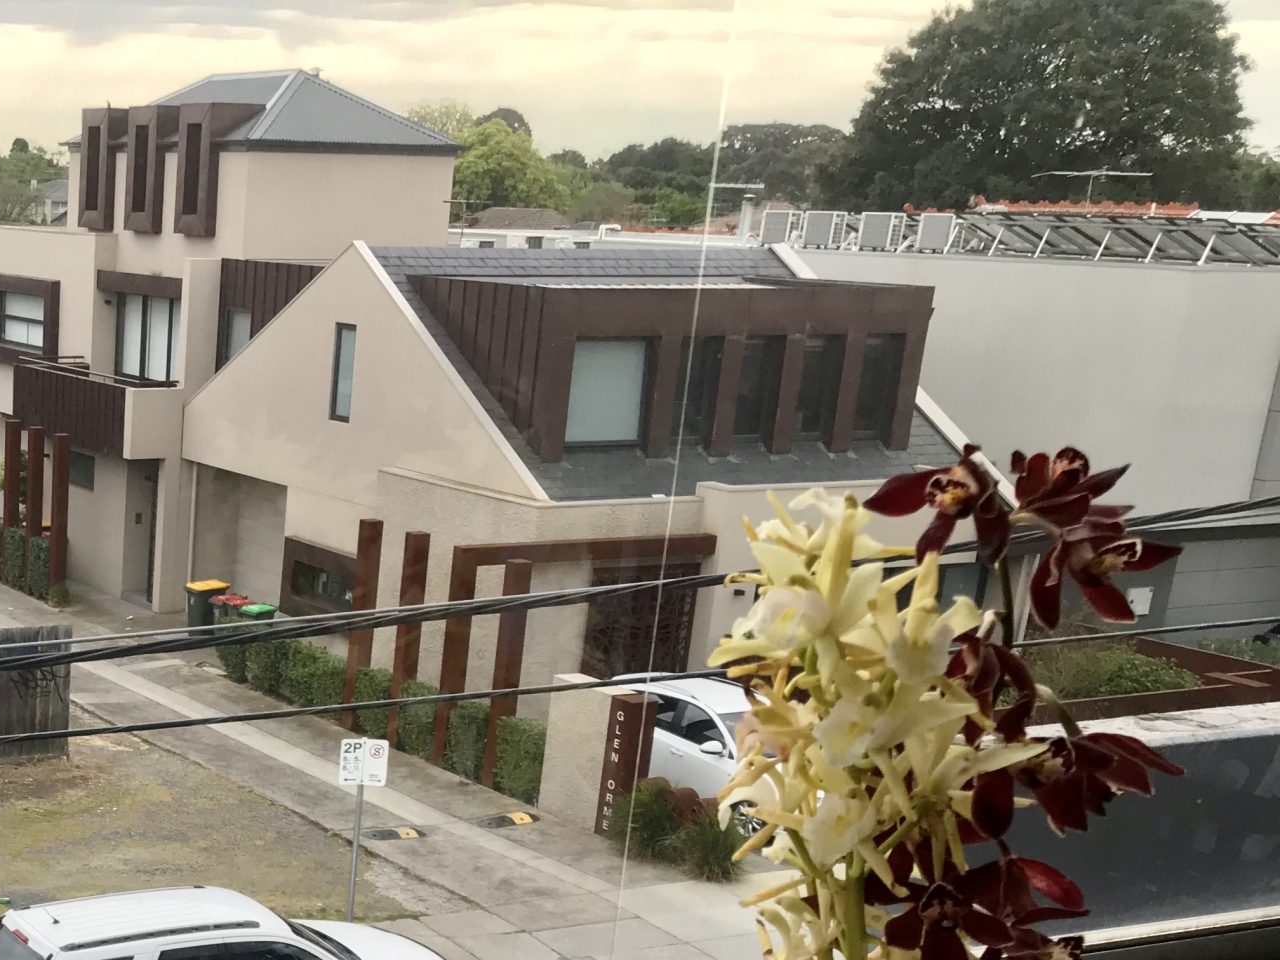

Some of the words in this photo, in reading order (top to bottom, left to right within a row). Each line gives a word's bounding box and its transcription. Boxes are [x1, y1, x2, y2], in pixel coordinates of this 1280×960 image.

[343, 742, 363, 754] 2P
[610, 711, 625, 763] GLEN
[602, 780, 616, 831] ORME
